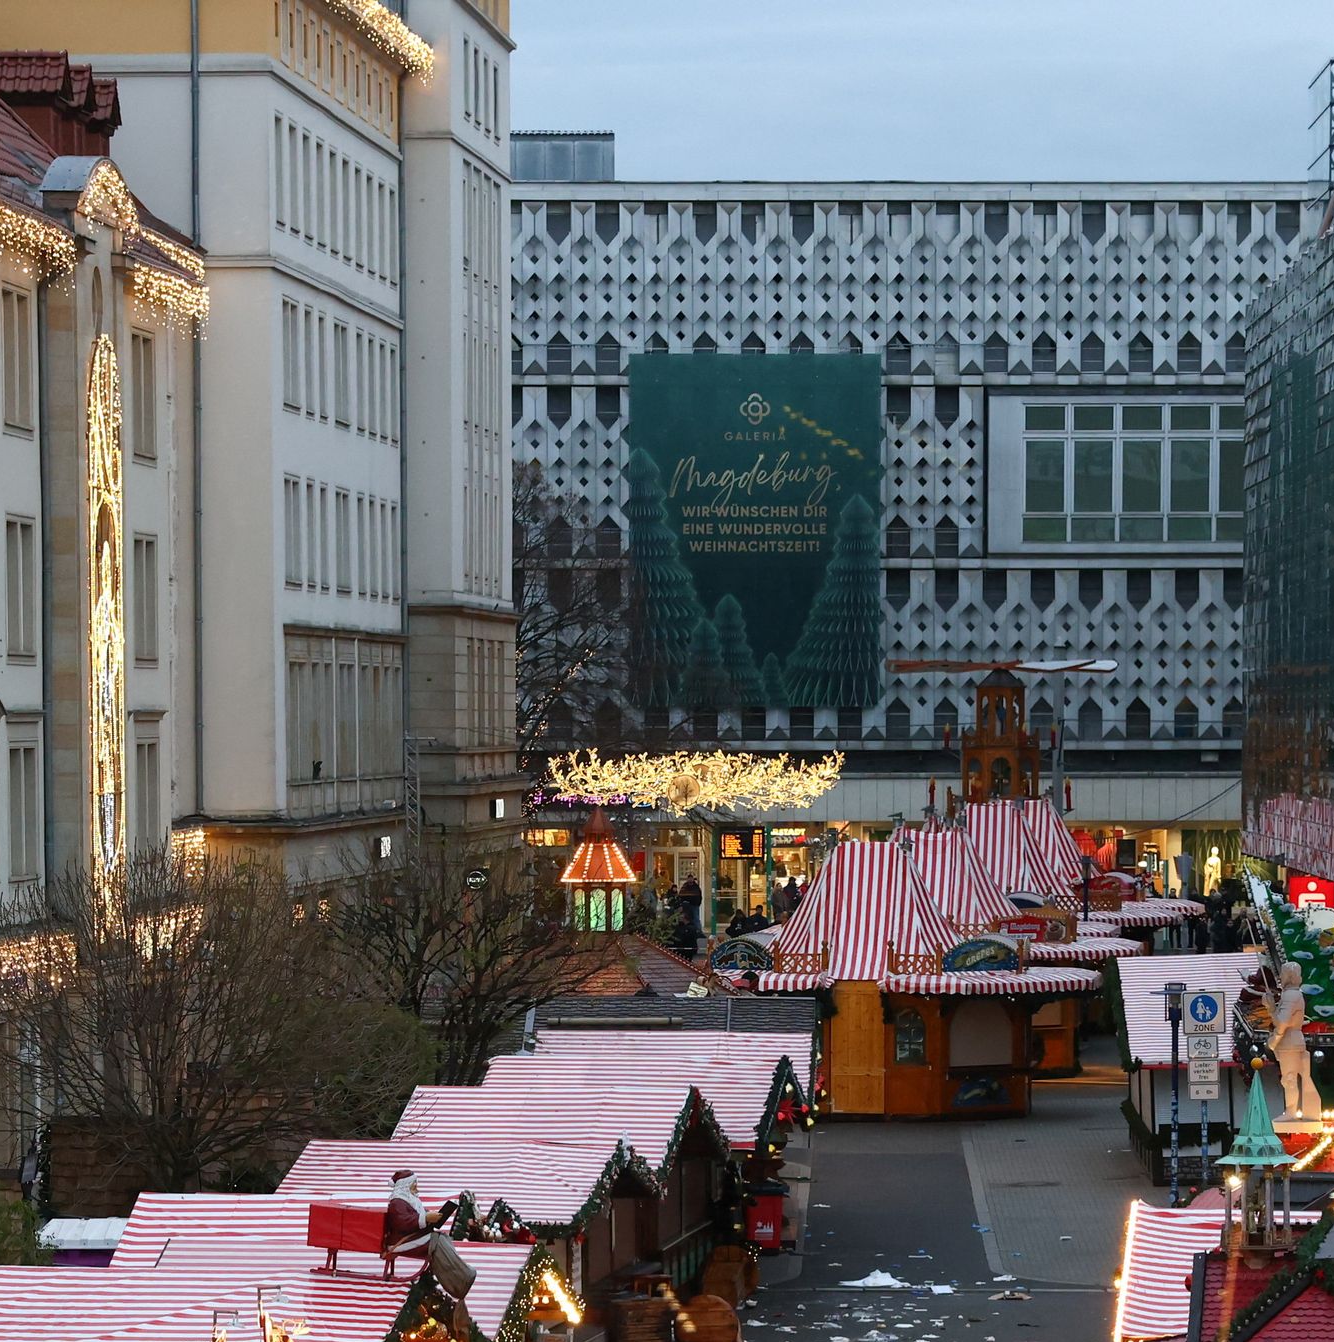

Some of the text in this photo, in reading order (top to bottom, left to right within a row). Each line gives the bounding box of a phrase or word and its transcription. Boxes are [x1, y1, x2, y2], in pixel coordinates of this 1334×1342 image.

[724, 432, 786, 442] GALERIA
[682, 504, 828, 518] WIR WÜNSCHEN DIR
[682, 523, 827, 535] EINE WUNDERVOLLE
[689, 540, 820, 552] WEIHNACHTSZEIT!
[1193, 1024, 1215, 1032] ZONE
